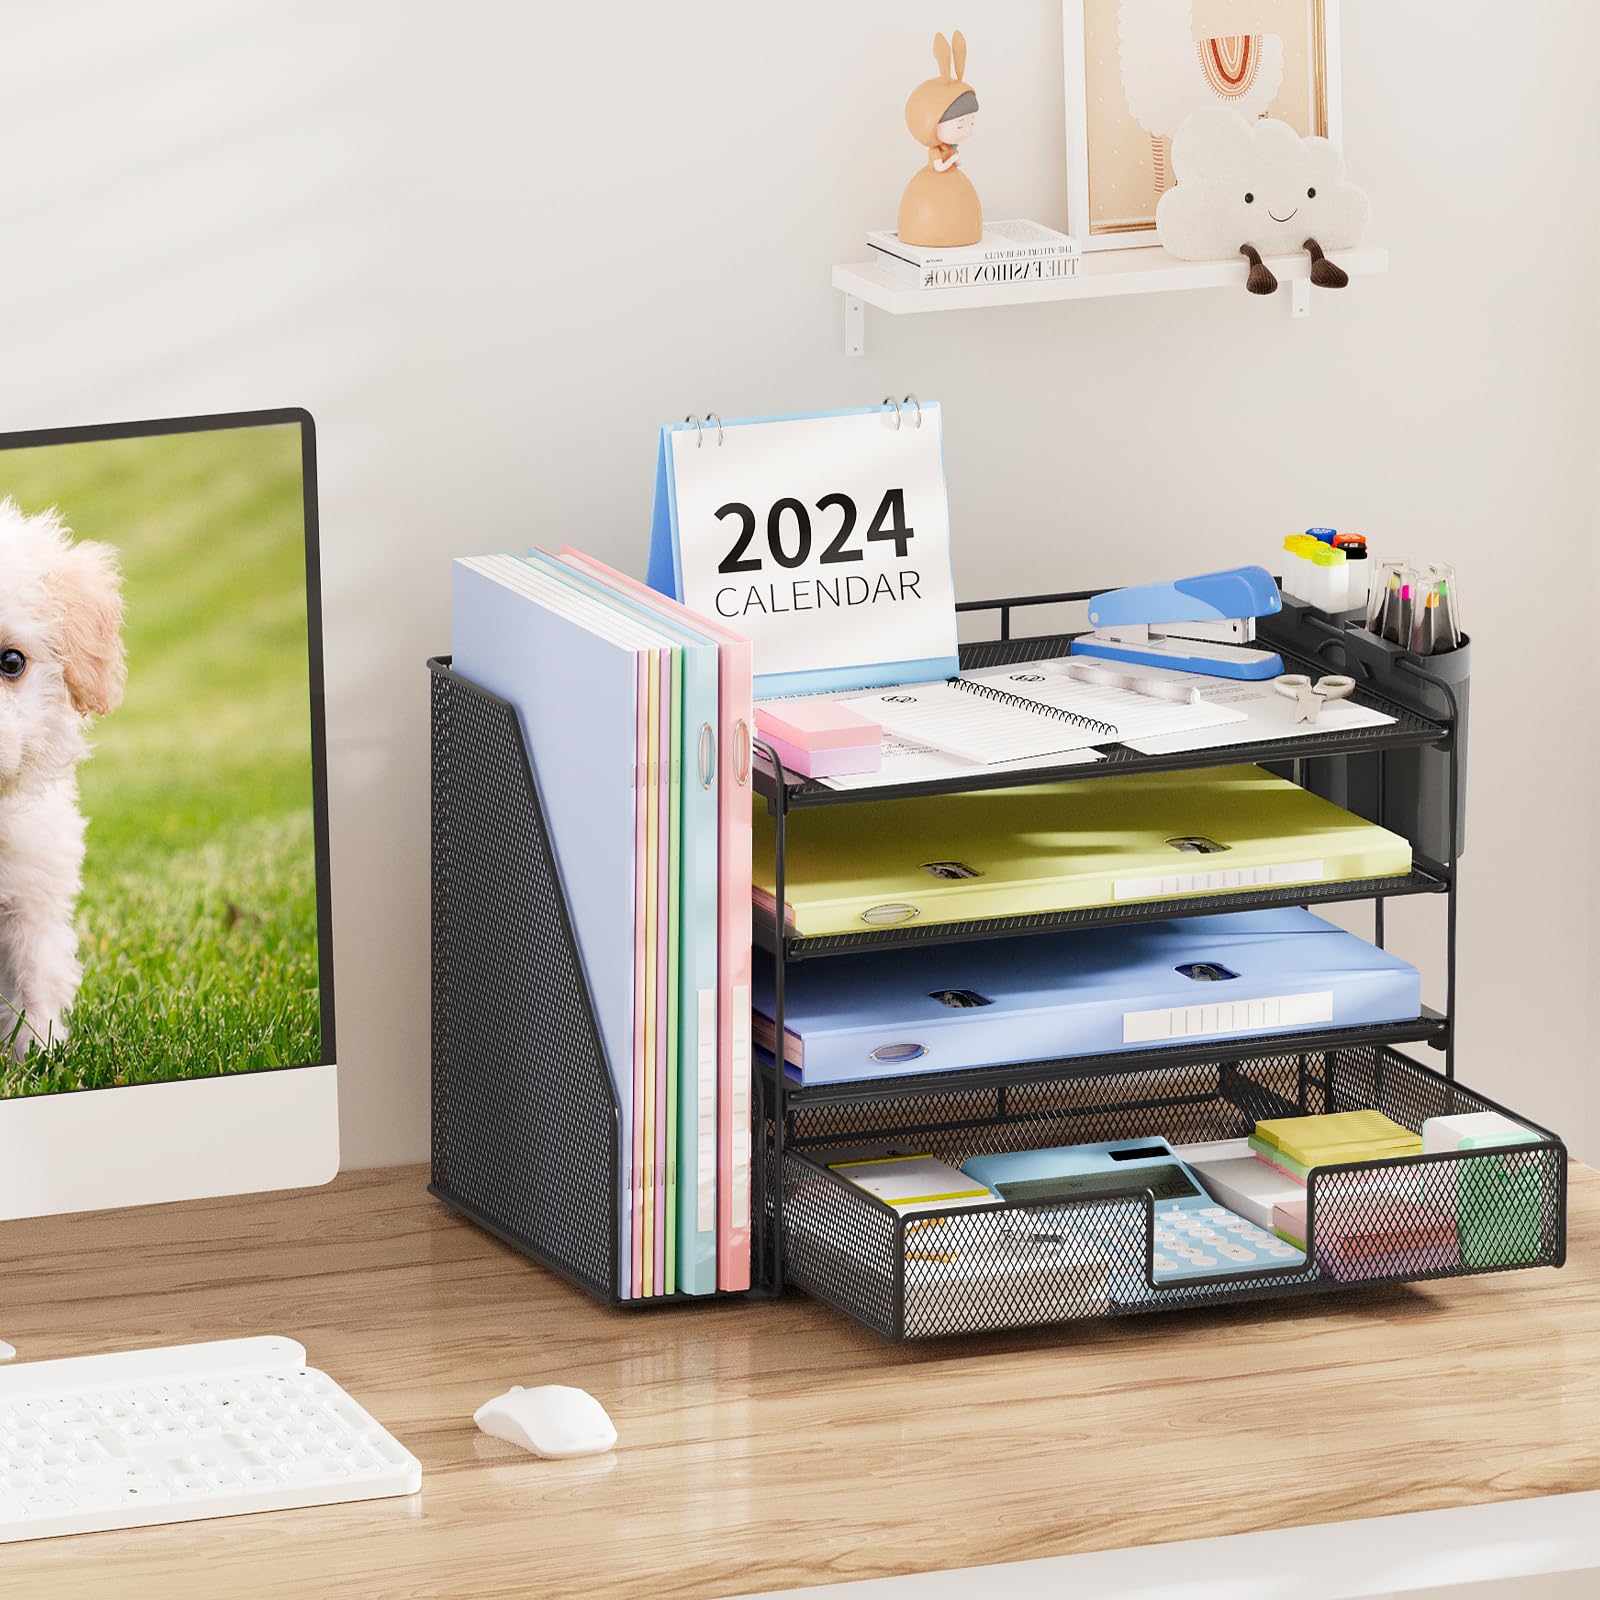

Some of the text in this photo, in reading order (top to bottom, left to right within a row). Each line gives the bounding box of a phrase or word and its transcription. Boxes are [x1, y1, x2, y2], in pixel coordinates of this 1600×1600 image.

[1057, 245, 1073, 254] THE
[713, 488, 915, 574] 2024
[715, 570, 922, 618] CALENDAR
